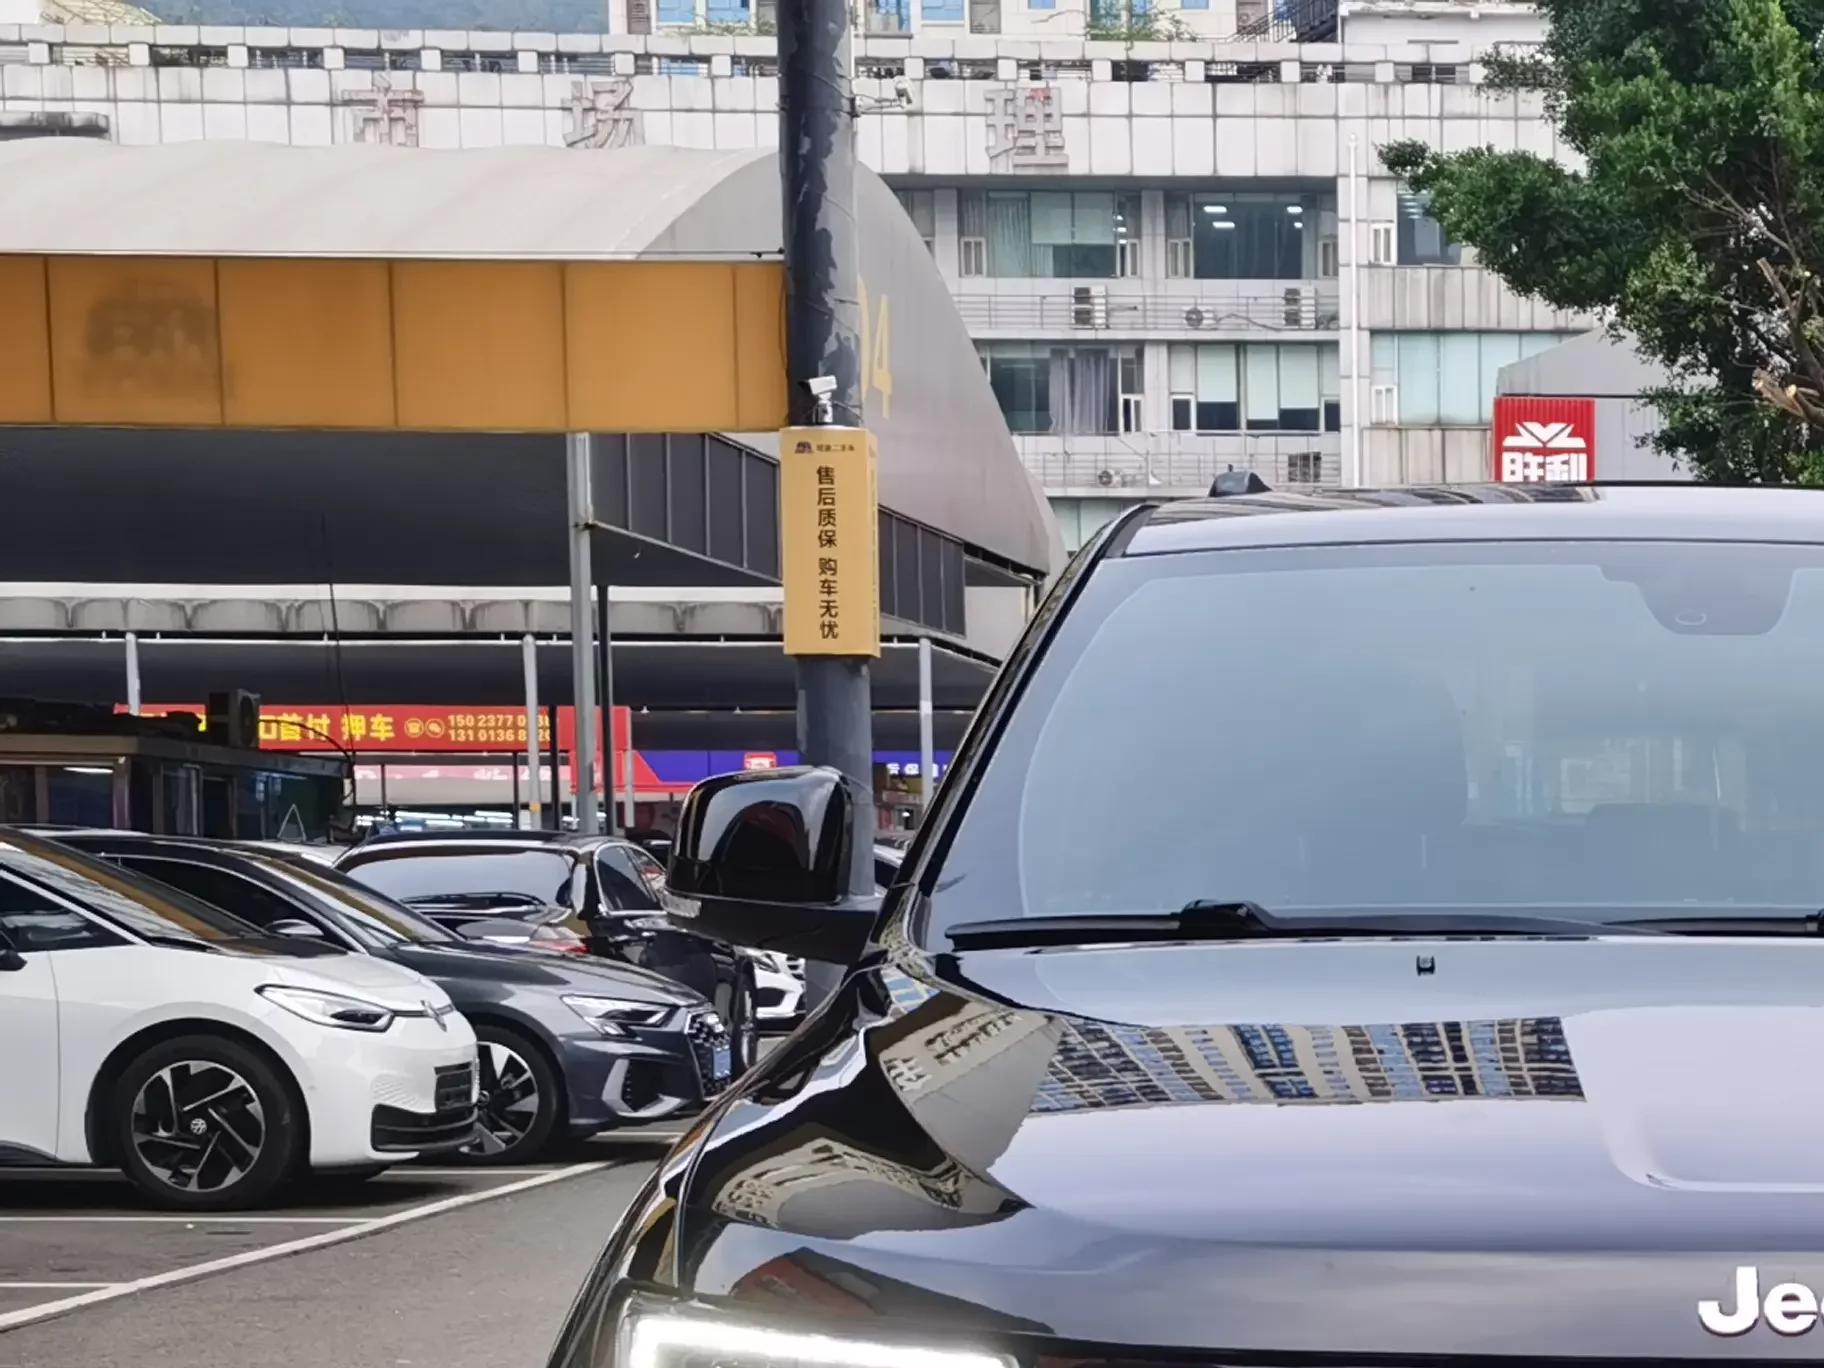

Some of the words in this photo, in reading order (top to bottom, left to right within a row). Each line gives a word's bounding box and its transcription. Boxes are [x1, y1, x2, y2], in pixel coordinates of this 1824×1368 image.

[816, 466, 837, 549] 售后质保
[818, 557, 839, 640] 购车无忧
[341, 712, 395, 742] 押车
[448, 714, 475, 728] 150
[477, 714, 514, 728] 2377
[448, 729, 474, 742] 131
[478, 729, 515, 742] 0136
